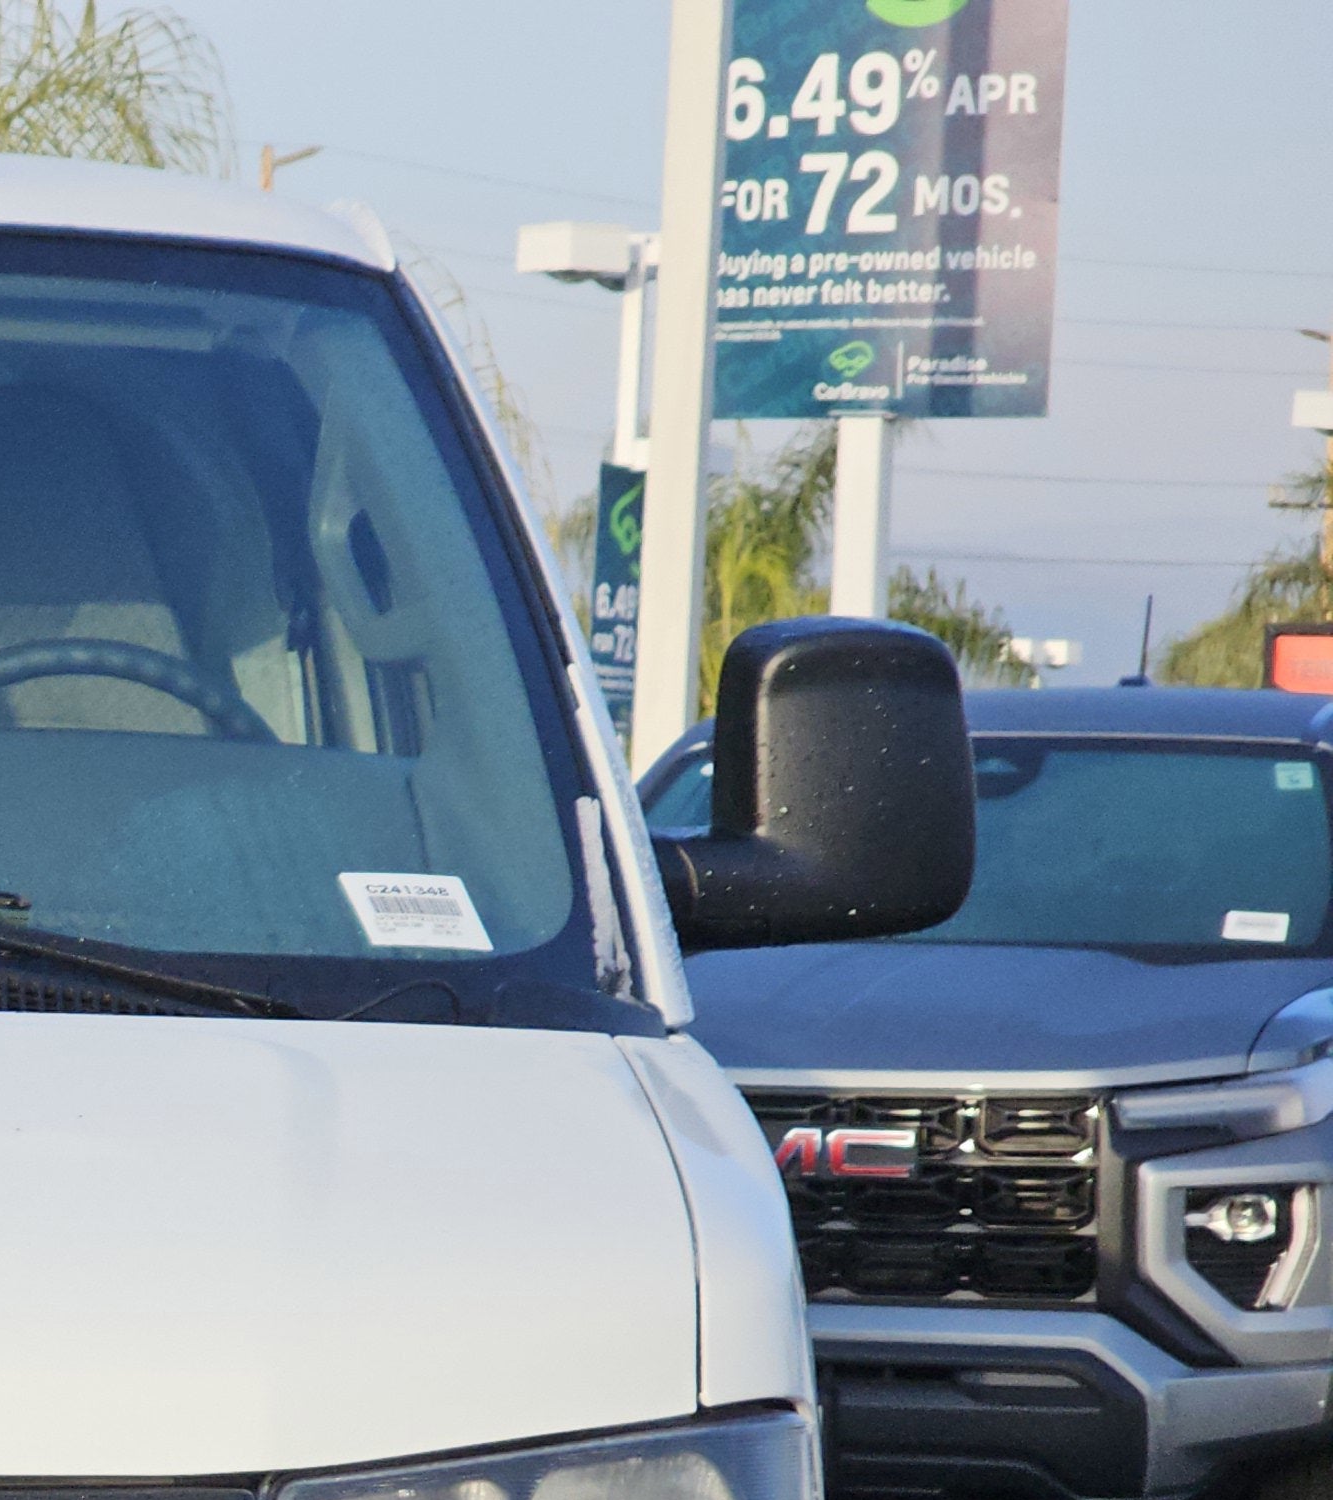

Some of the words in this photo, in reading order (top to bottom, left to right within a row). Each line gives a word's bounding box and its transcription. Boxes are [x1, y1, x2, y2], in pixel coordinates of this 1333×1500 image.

[944, 73, 1039, 116] APR
[799, 150, 900, 235] 72
[912, 174, 1023, 220] MOS.
[790, 252, 805, 274] a
[808, 245, 940, 280] pre-owned
[945, 243, 1038, 271] vehicle
[752, 284, 818, 307] never
[820, 278, 864, 305] felt
[865, 277, 952, 305] better.
